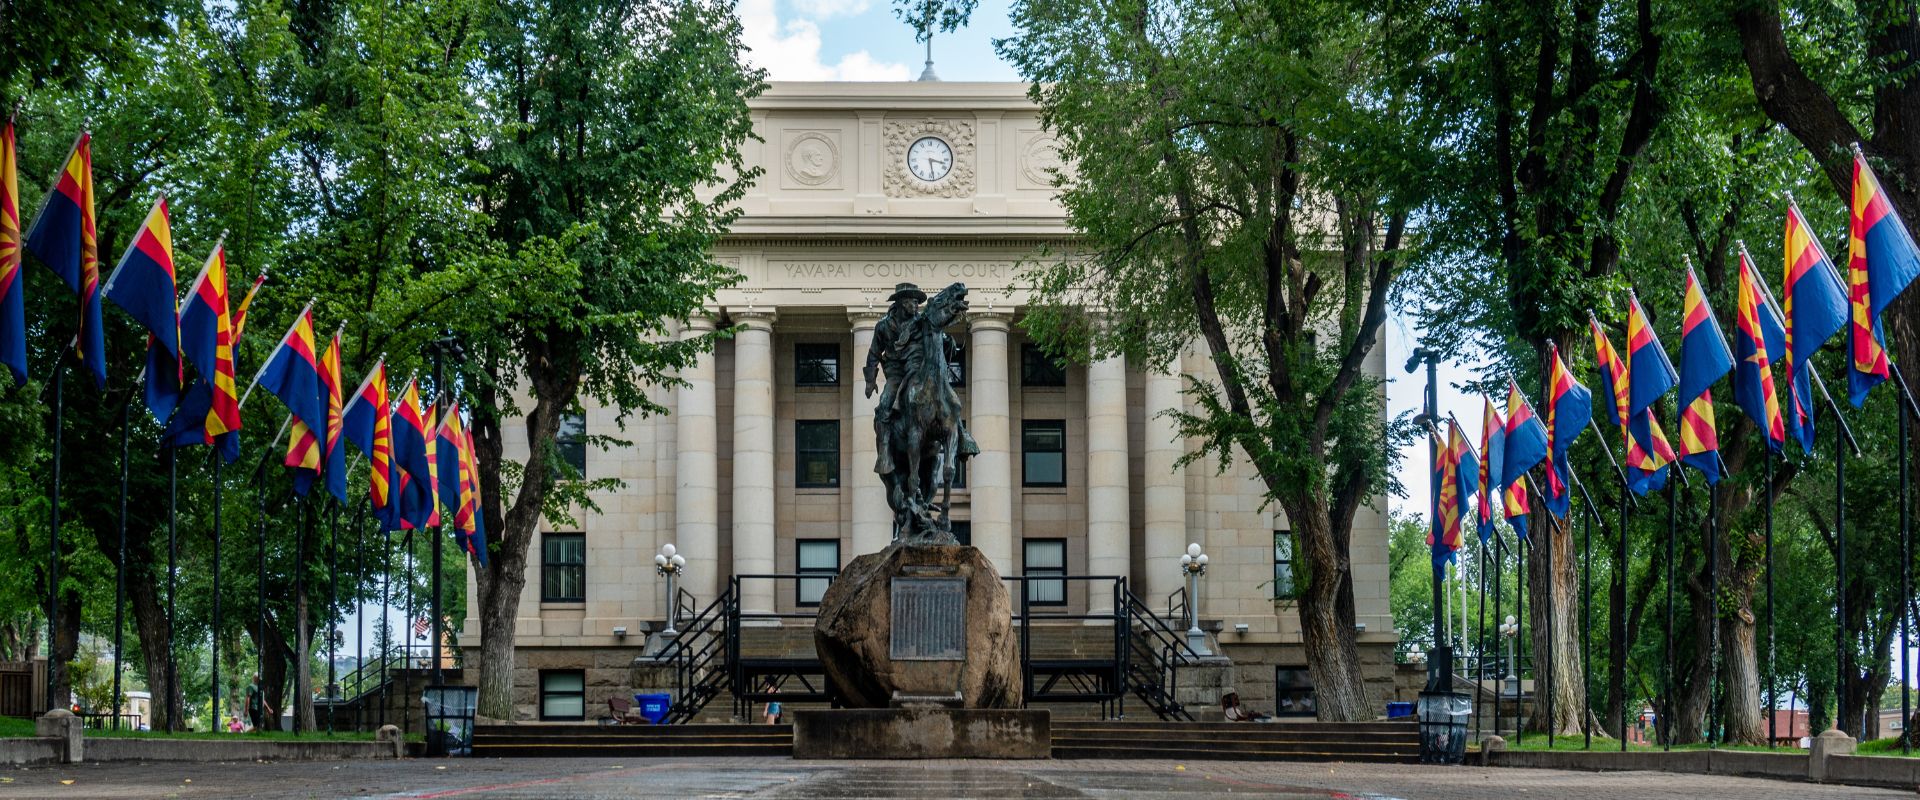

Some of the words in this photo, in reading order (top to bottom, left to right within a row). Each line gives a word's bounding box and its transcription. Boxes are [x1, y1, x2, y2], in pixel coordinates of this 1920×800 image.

[783, 263, 851, 278] YAVAPAI
[863, 263, 938, 278] COUNTY
[947, 263, 1009, 278] COURT
